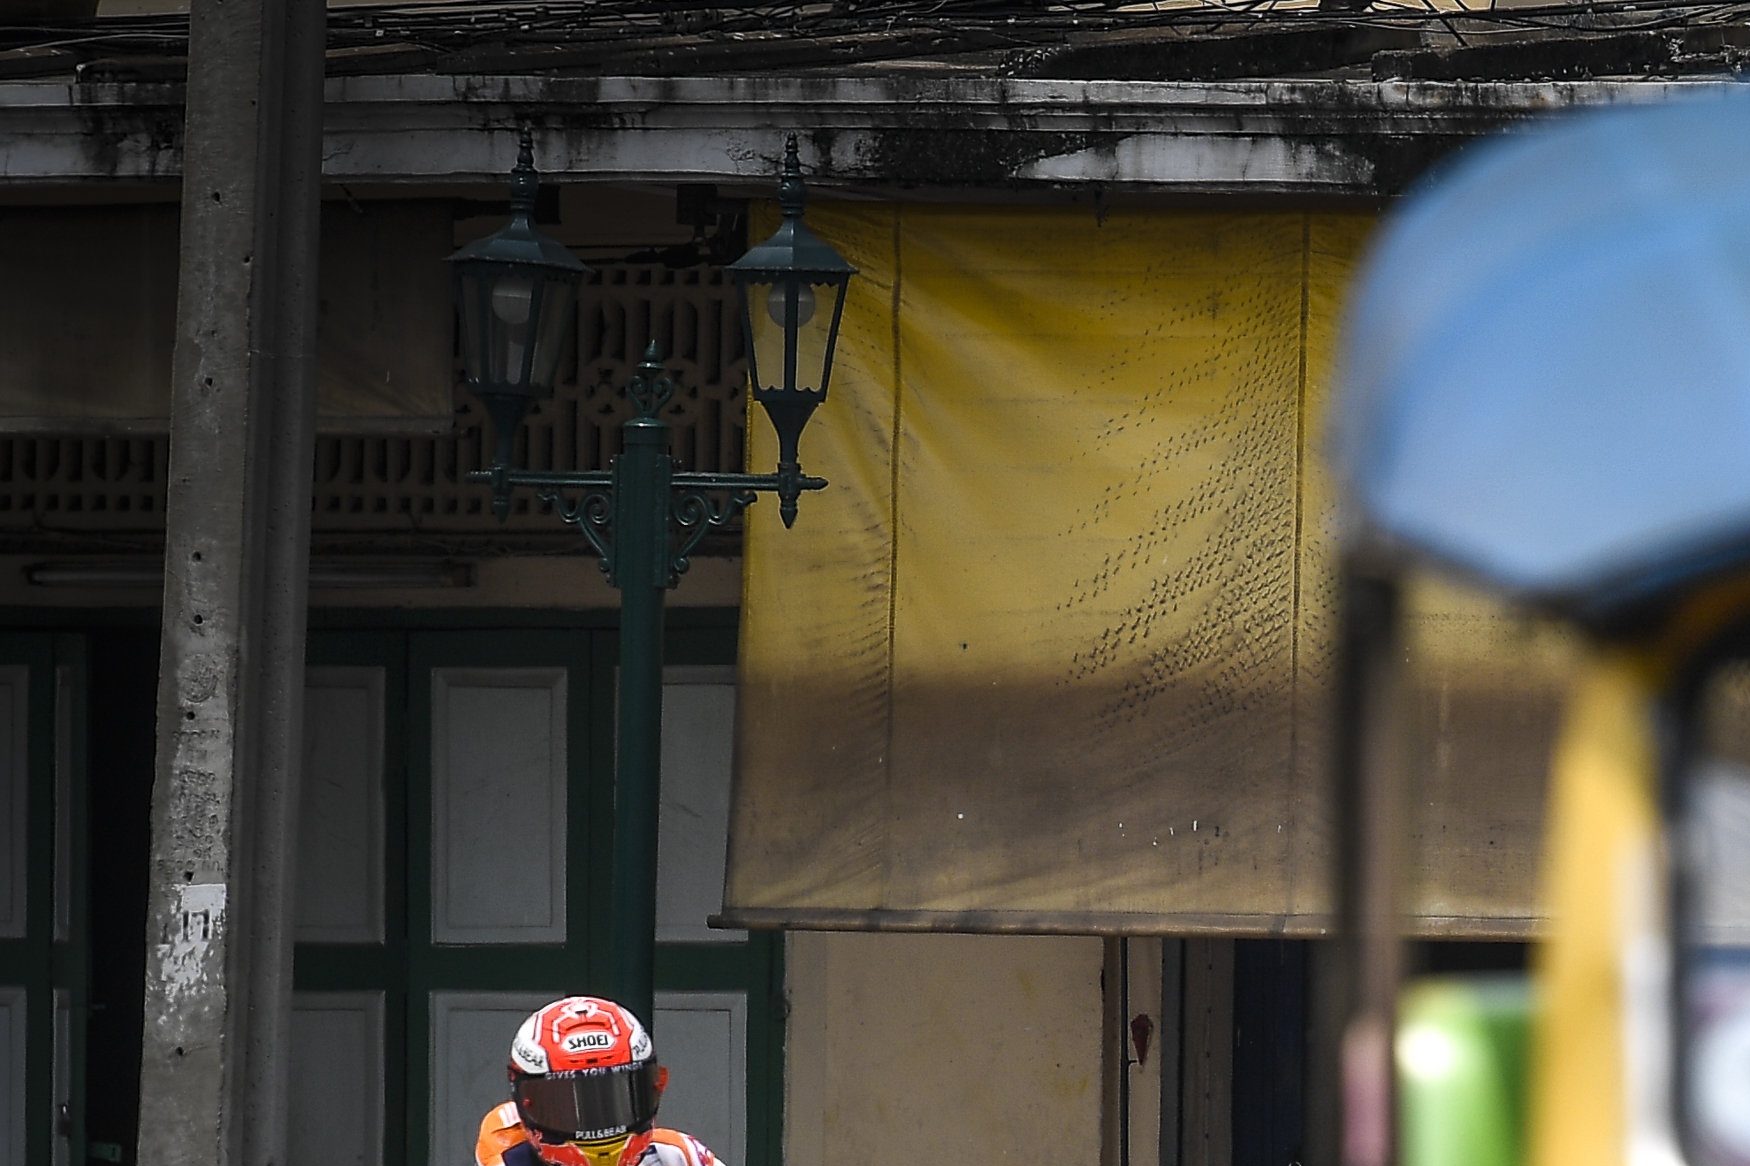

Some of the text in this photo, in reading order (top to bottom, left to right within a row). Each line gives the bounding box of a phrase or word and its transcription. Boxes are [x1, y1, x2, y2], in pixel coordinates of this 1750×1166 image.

[568, 1033, 609, 1050] SHOEI
[546, 1068, 577, 1081] GIVES
[583, 1066, 607, 1079] YOU
[575, 1124, 628, 1141] PULL&BEAR
